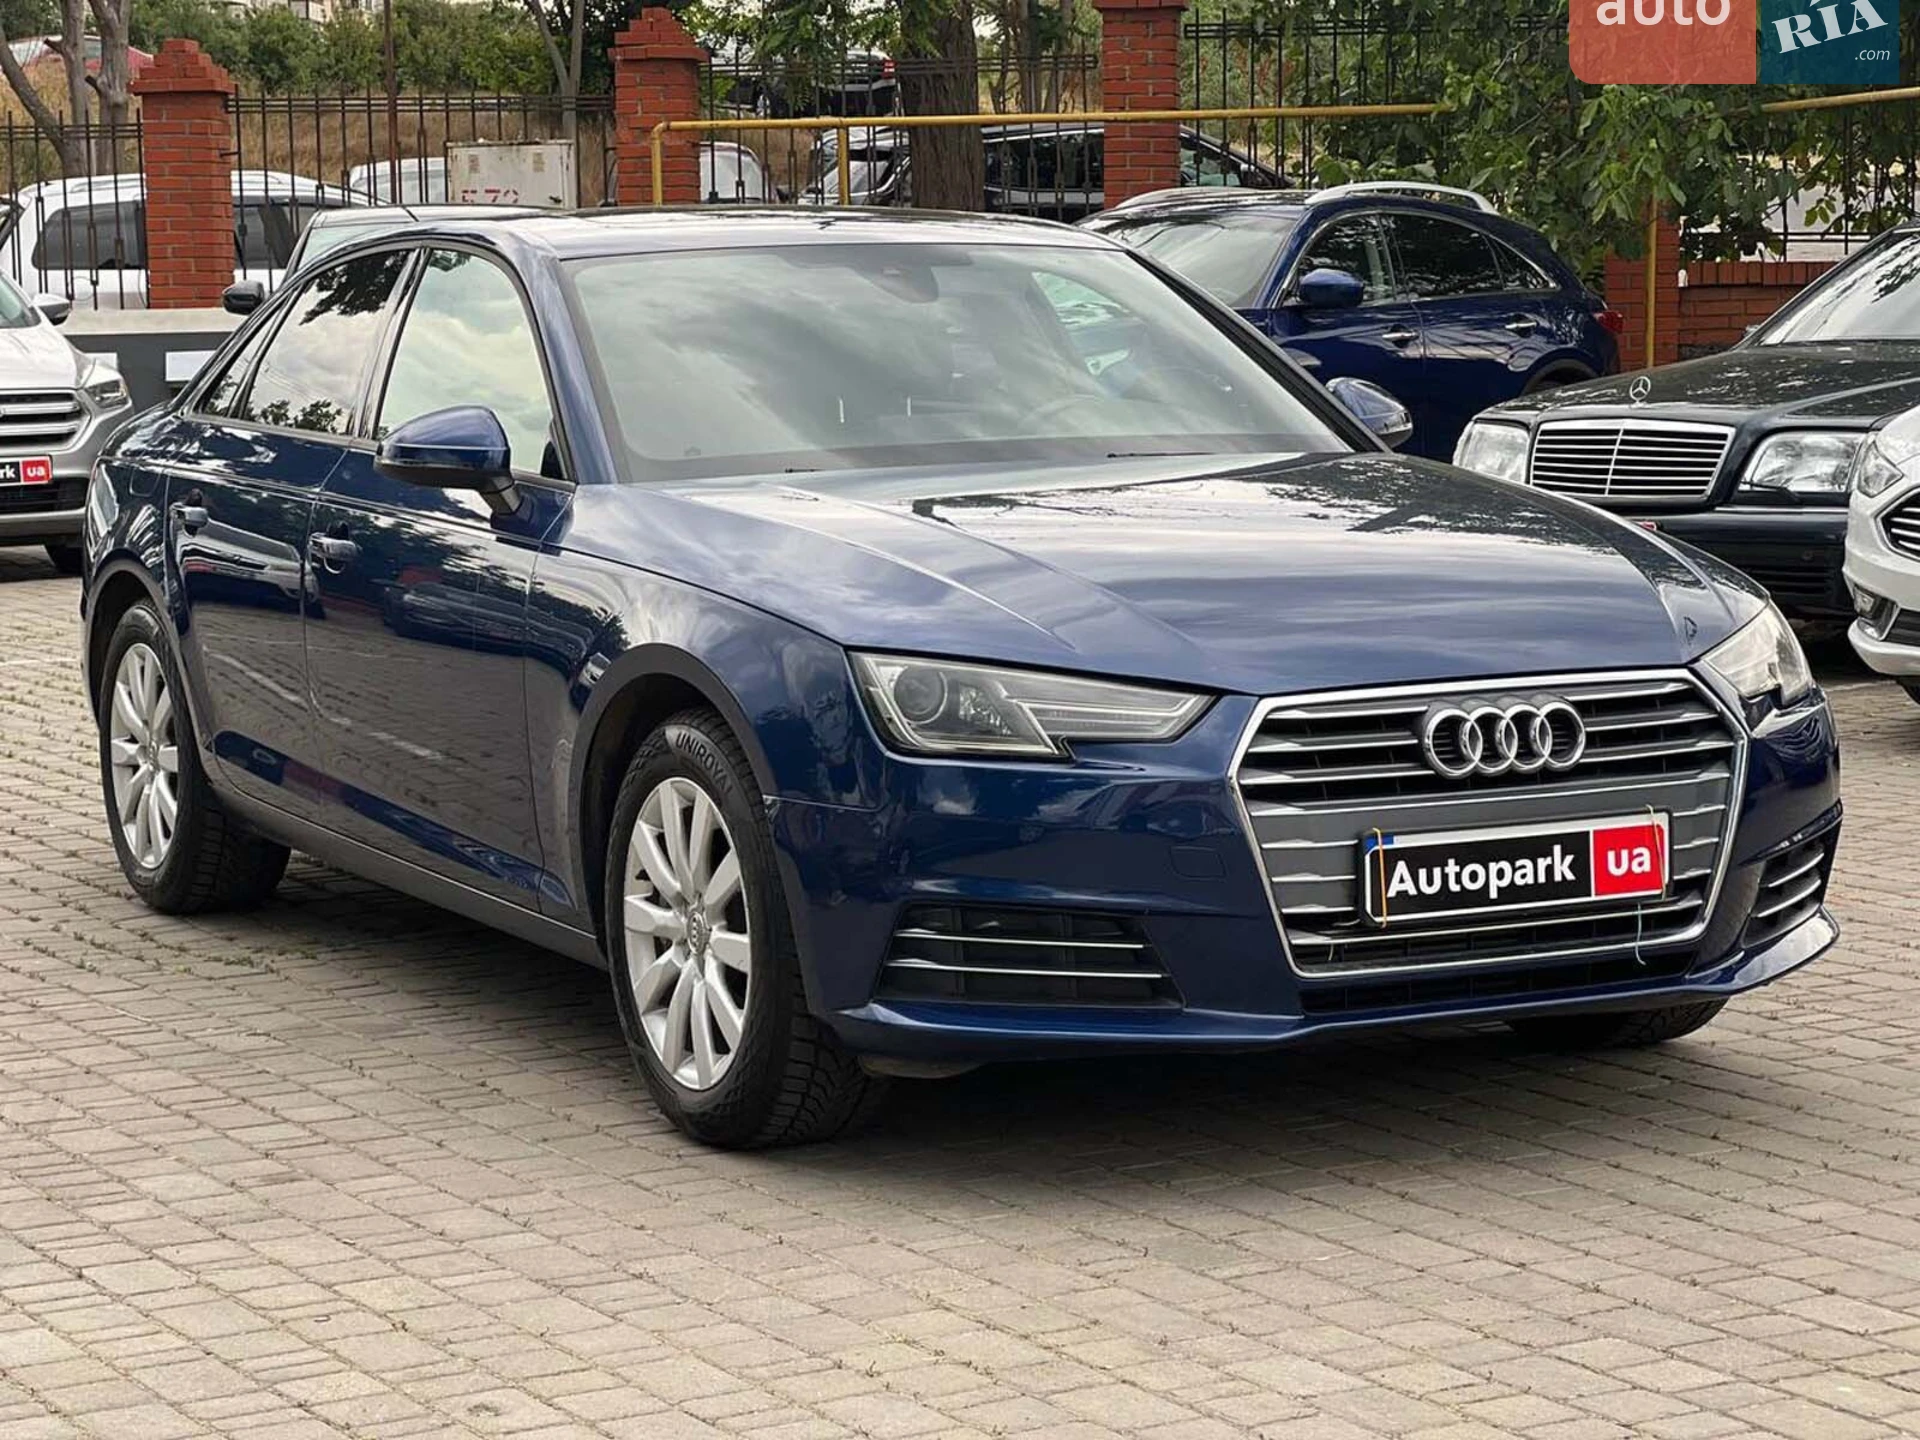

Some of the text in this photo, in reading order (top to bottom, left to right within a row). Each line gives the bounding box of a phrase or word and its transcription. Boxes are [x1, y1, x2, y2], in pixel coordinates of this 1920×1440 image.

[27, 466, 46, 478] ua
[1386, 844, 1651, 899] Autopark ua
